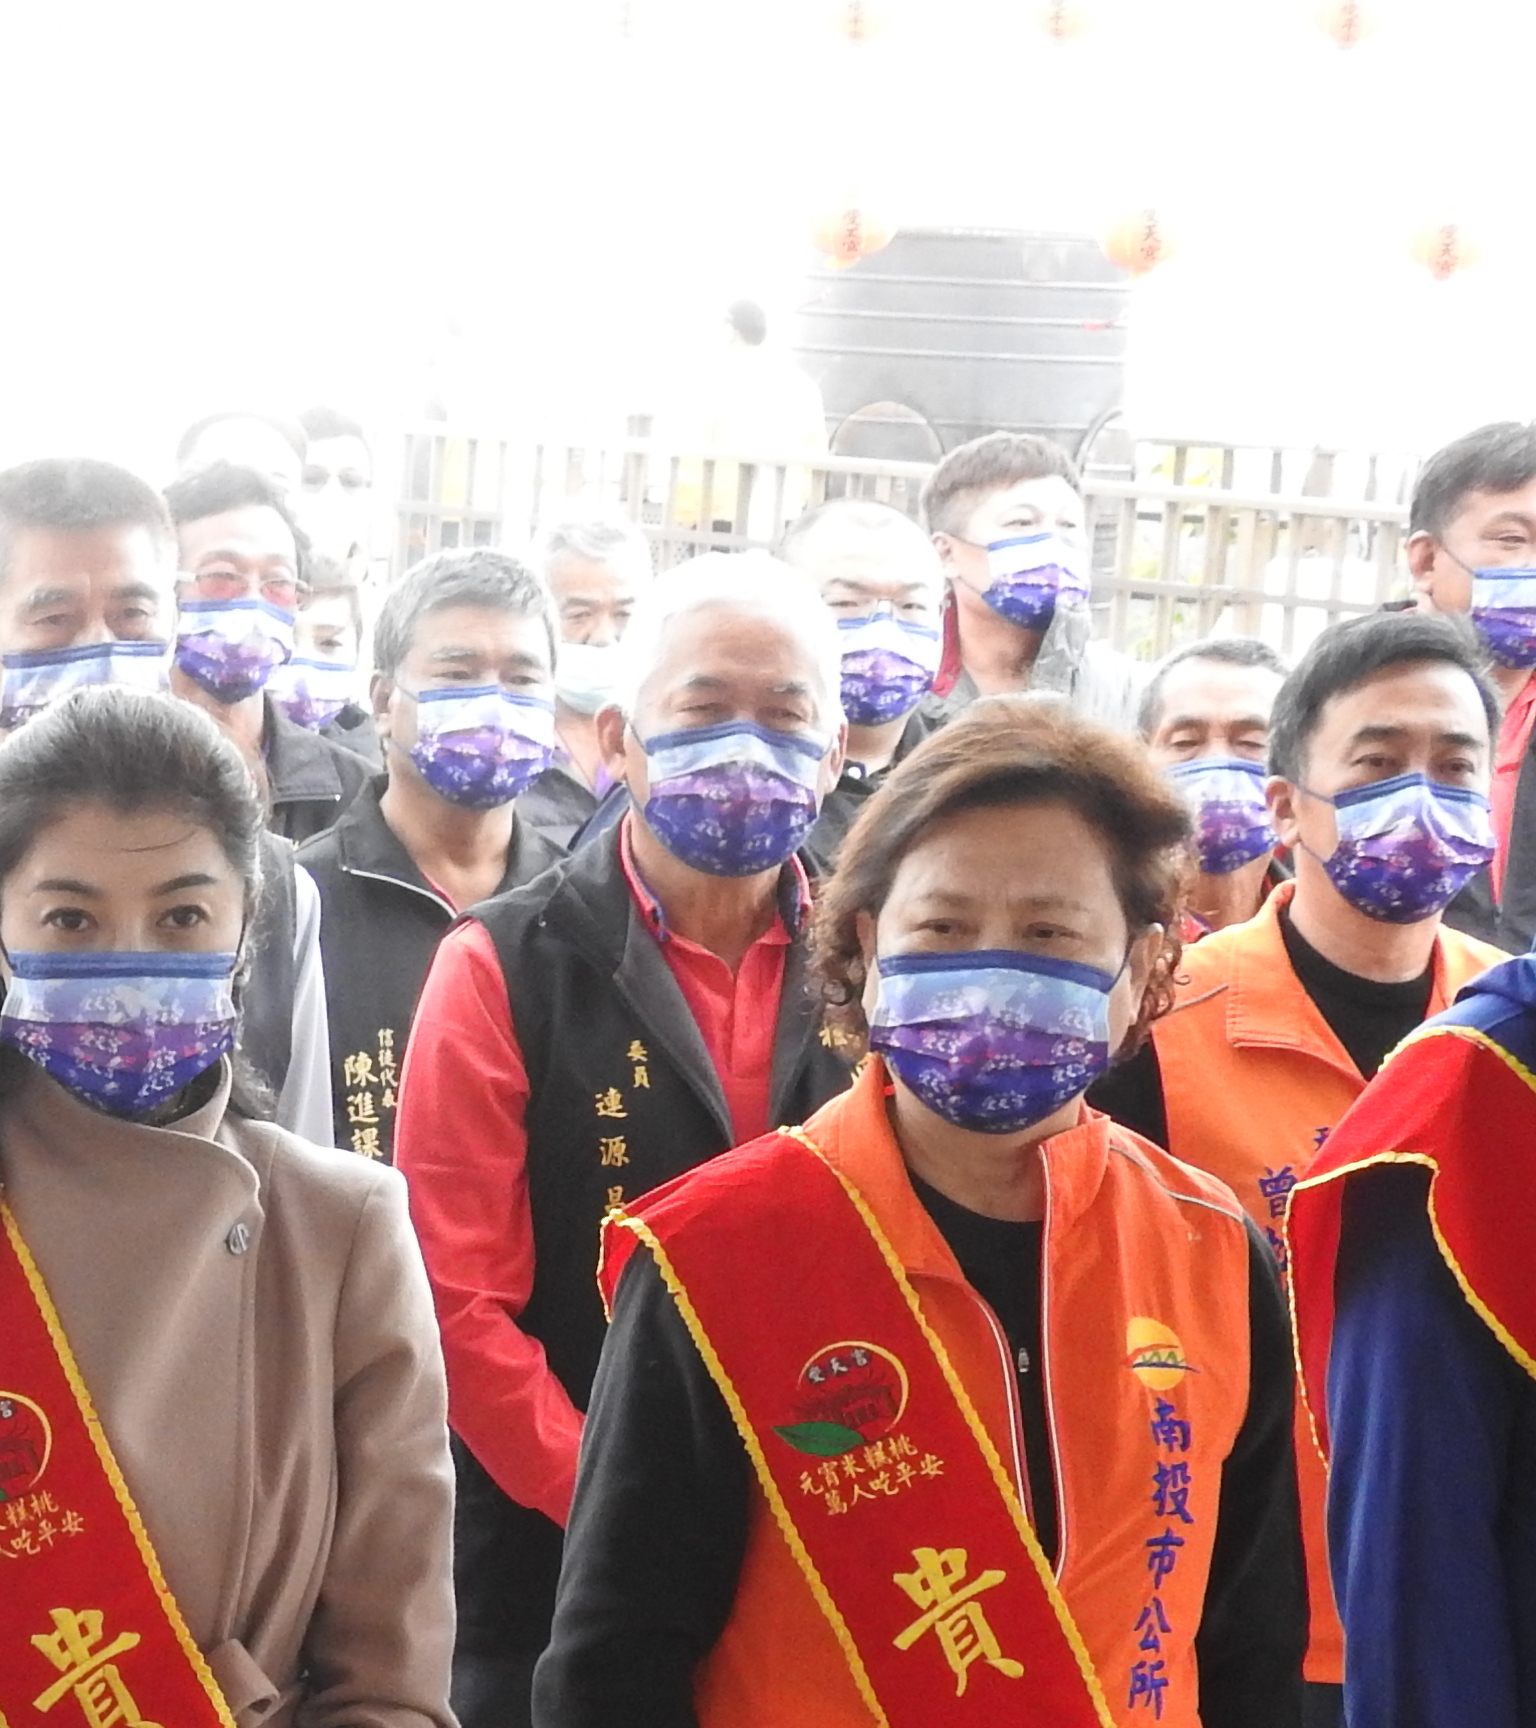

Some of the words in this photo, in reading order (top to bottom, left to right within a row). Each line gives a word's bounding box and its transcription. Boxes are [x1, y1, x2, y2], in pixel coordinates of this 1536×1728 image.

[627, 1040, 651, 1089] 委員
[824, 1453, 944, 1515] 萬人吃平安
[1127, 1397, 1193, 1721] 南投市公所
